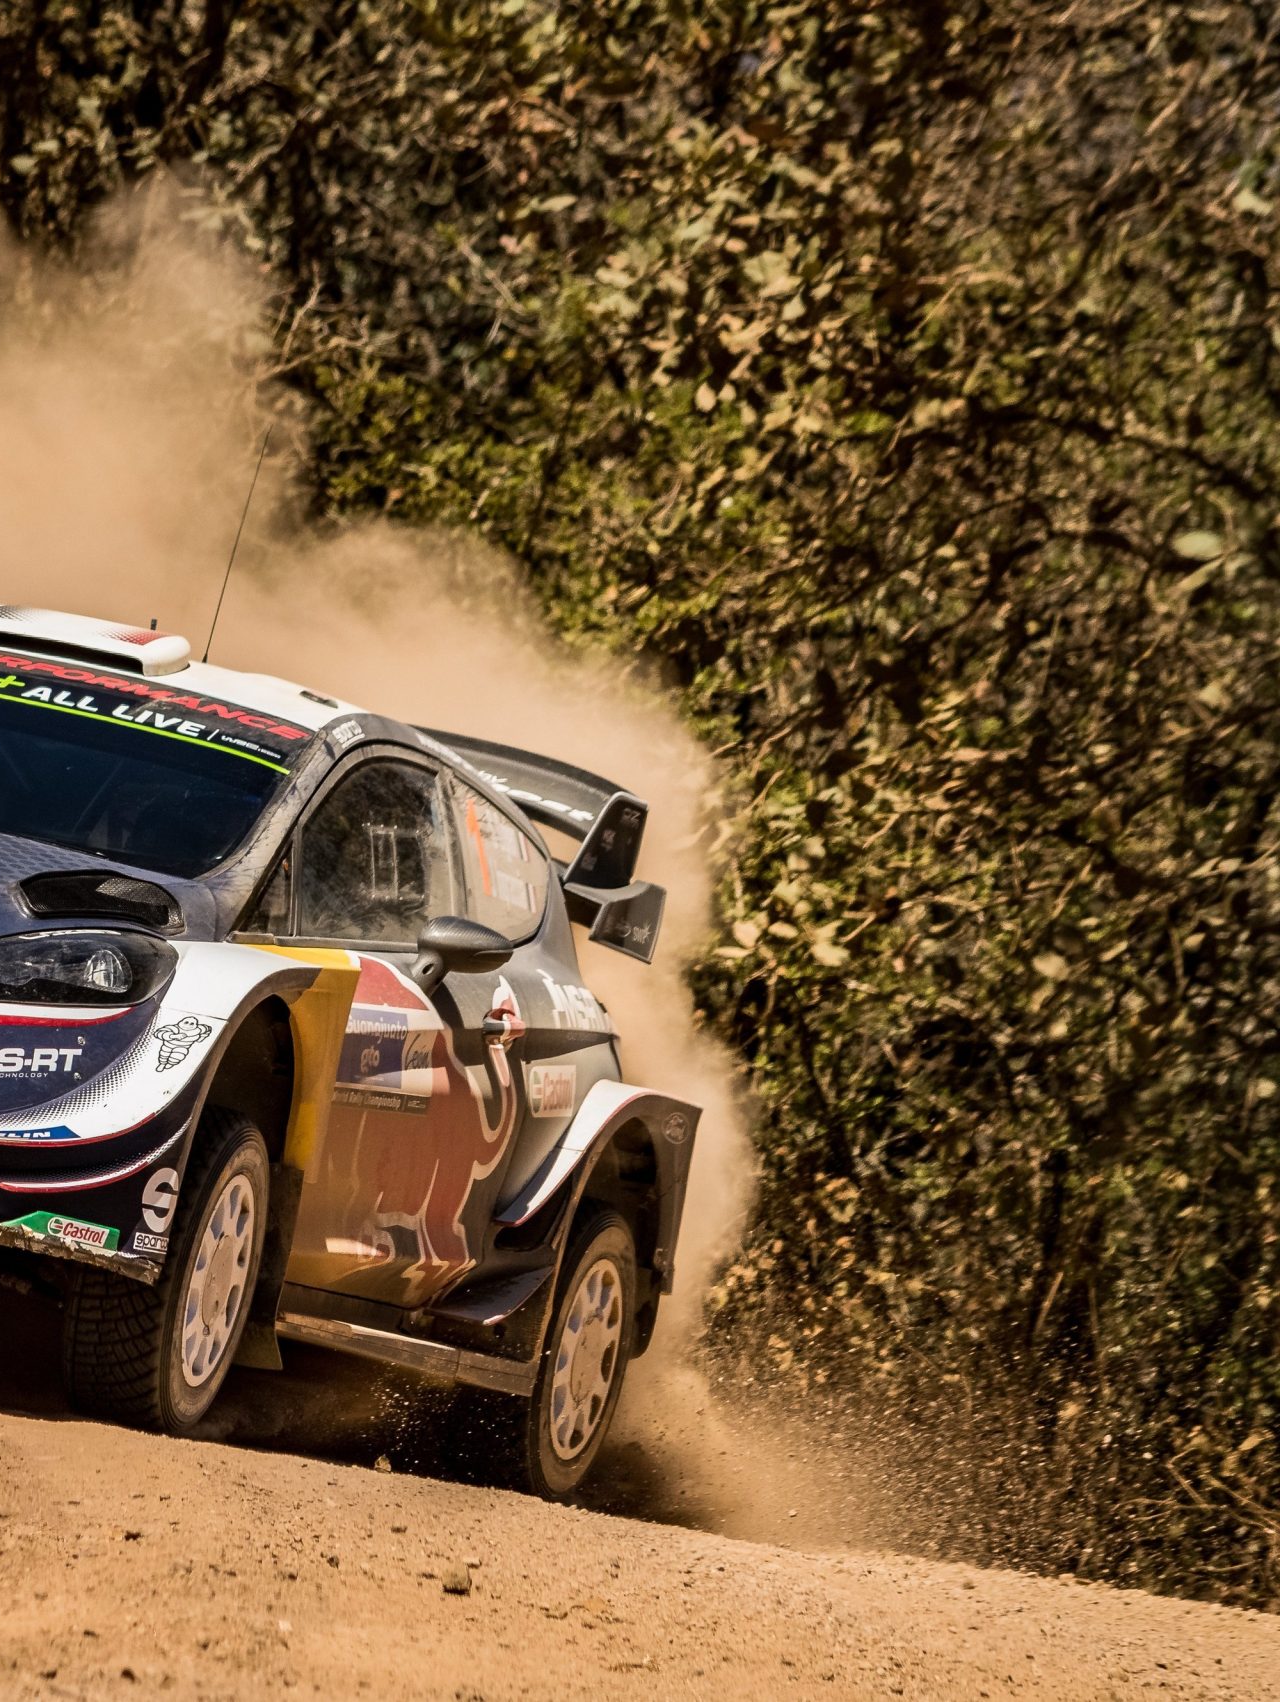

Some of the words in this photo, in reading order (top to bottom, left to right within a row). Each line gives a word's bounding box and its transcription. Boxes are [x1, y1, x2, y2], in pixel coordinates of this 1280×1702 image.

[20, 686, 99, 711] ALL
[111, 704, 207, 737] LIVE
[62, 1222, 105, 1243] Castrol
